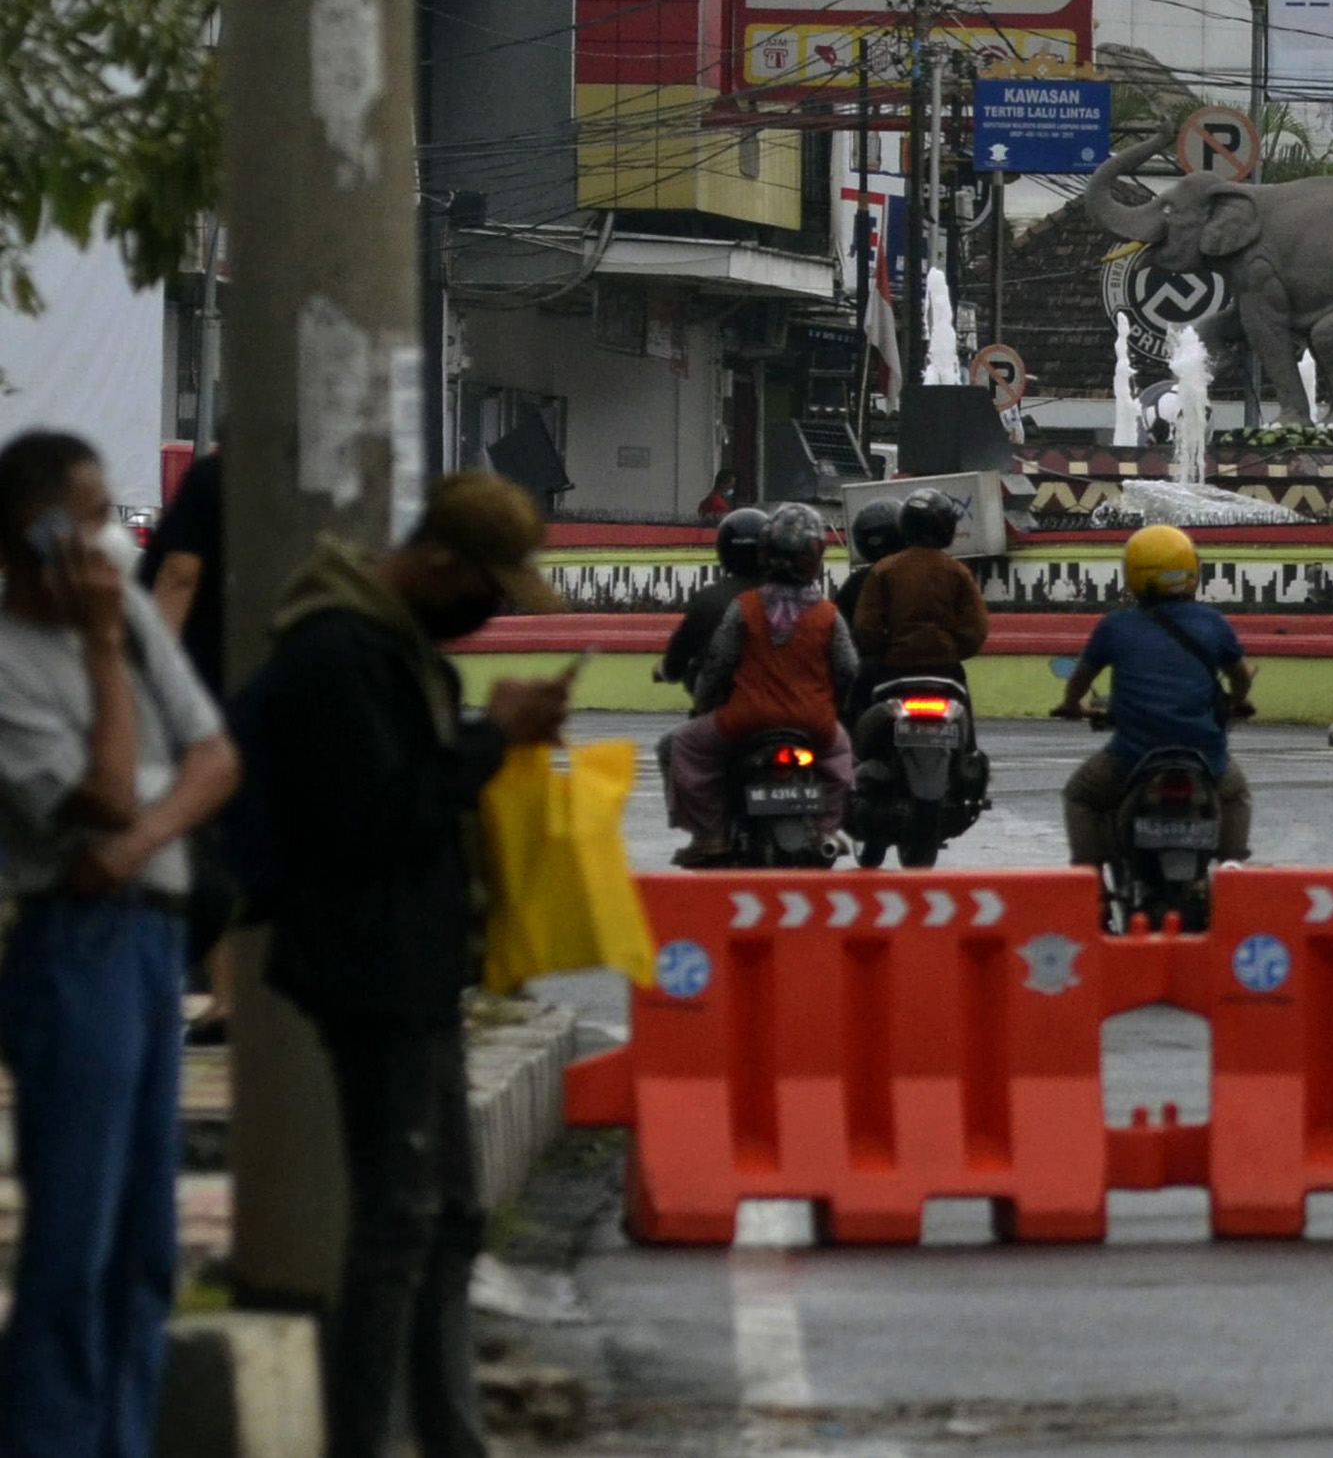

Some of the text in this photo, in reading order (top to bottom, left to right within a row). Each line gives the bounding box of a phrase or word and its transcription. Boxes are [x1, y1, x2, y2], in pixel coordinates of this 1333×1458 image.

[1004, 88, 1080, 104] KAWASAN
[984, 105, 1100, 119] TERTIB LALU LINTAS
